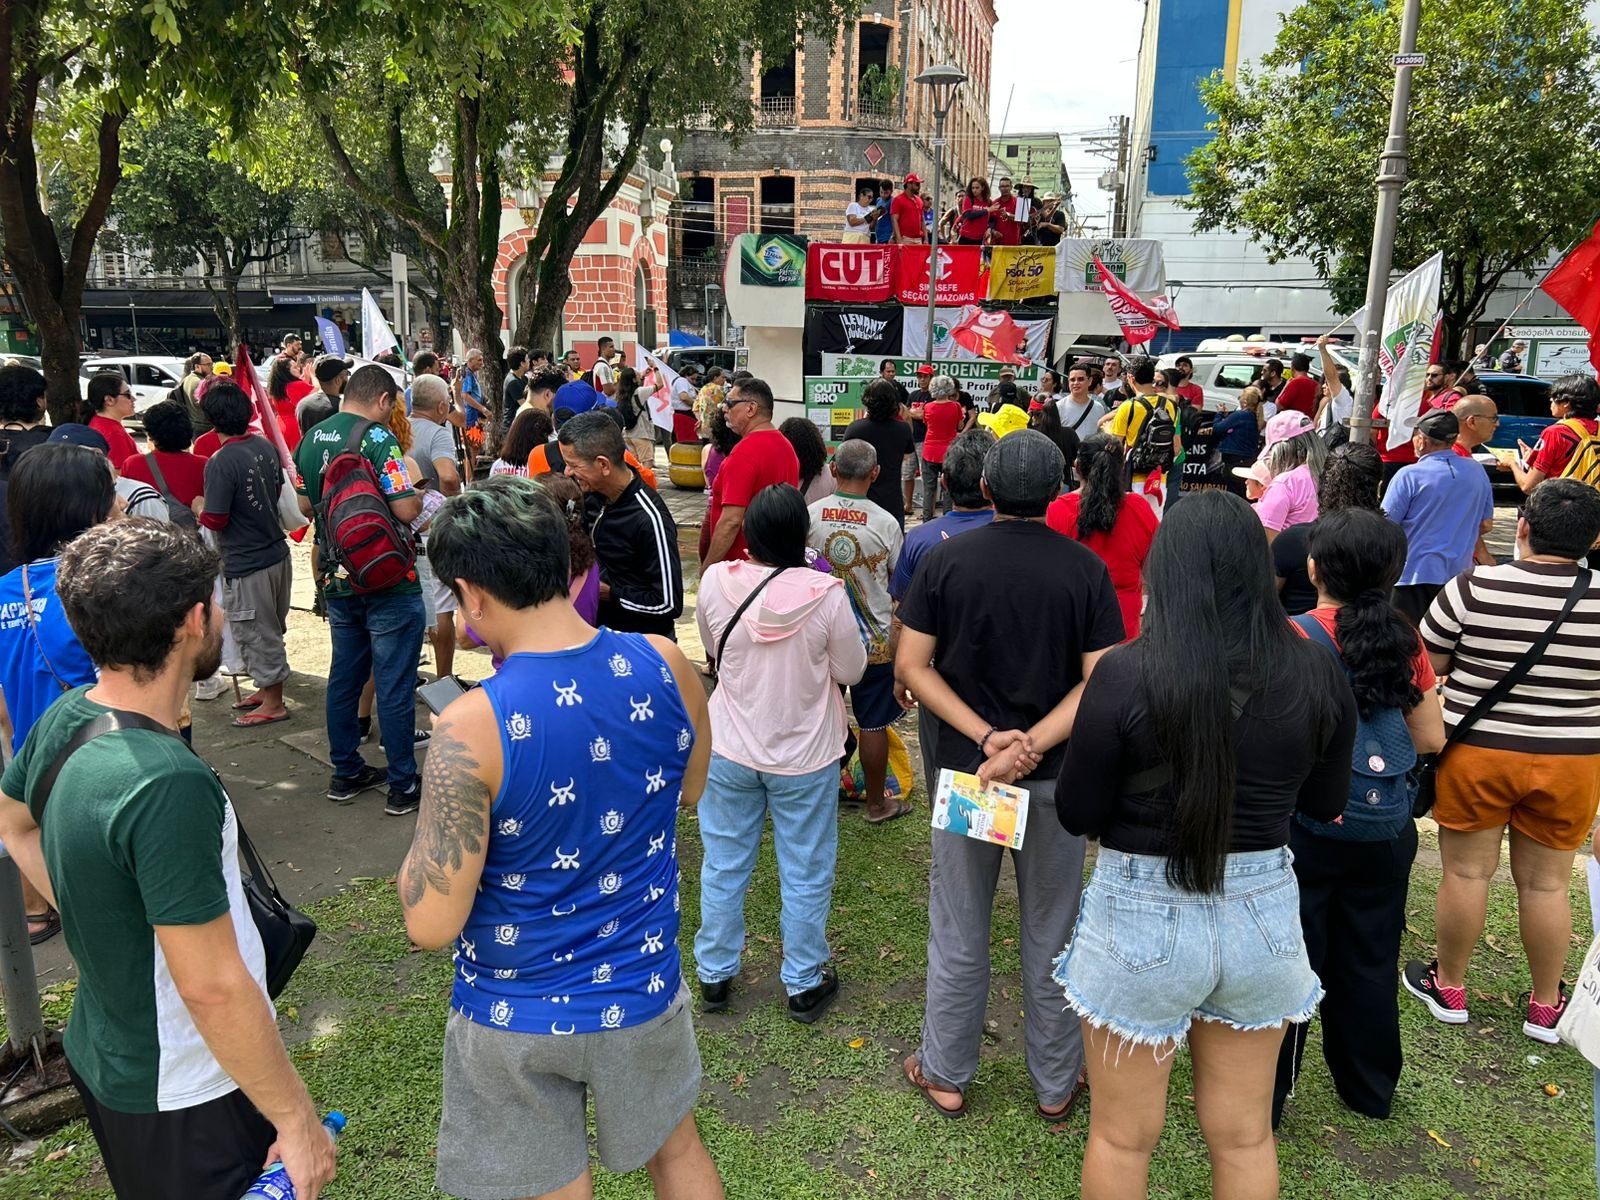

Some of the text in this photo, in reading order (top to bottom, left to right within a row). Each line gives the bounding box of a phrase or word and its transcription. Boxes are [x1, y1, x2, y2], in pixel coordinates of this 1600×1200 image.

[1395, 56, 1423, 64] 343050
[822, 251, 883, 285] CUT
[883, 247, 891, 283] BRASIL
[1028, 265, 1044, 277] 50
[1089, 264, 1124, 274] ASROM
[902, 290, 975, 302] SEÇÃO MAZONAS
[814, 383, 846, 394] OUTU
[814, 393, 838, 403] BRO
[313, 429, 342, 444] Paulo
[822, 508, 868, 524] DEVASSA
